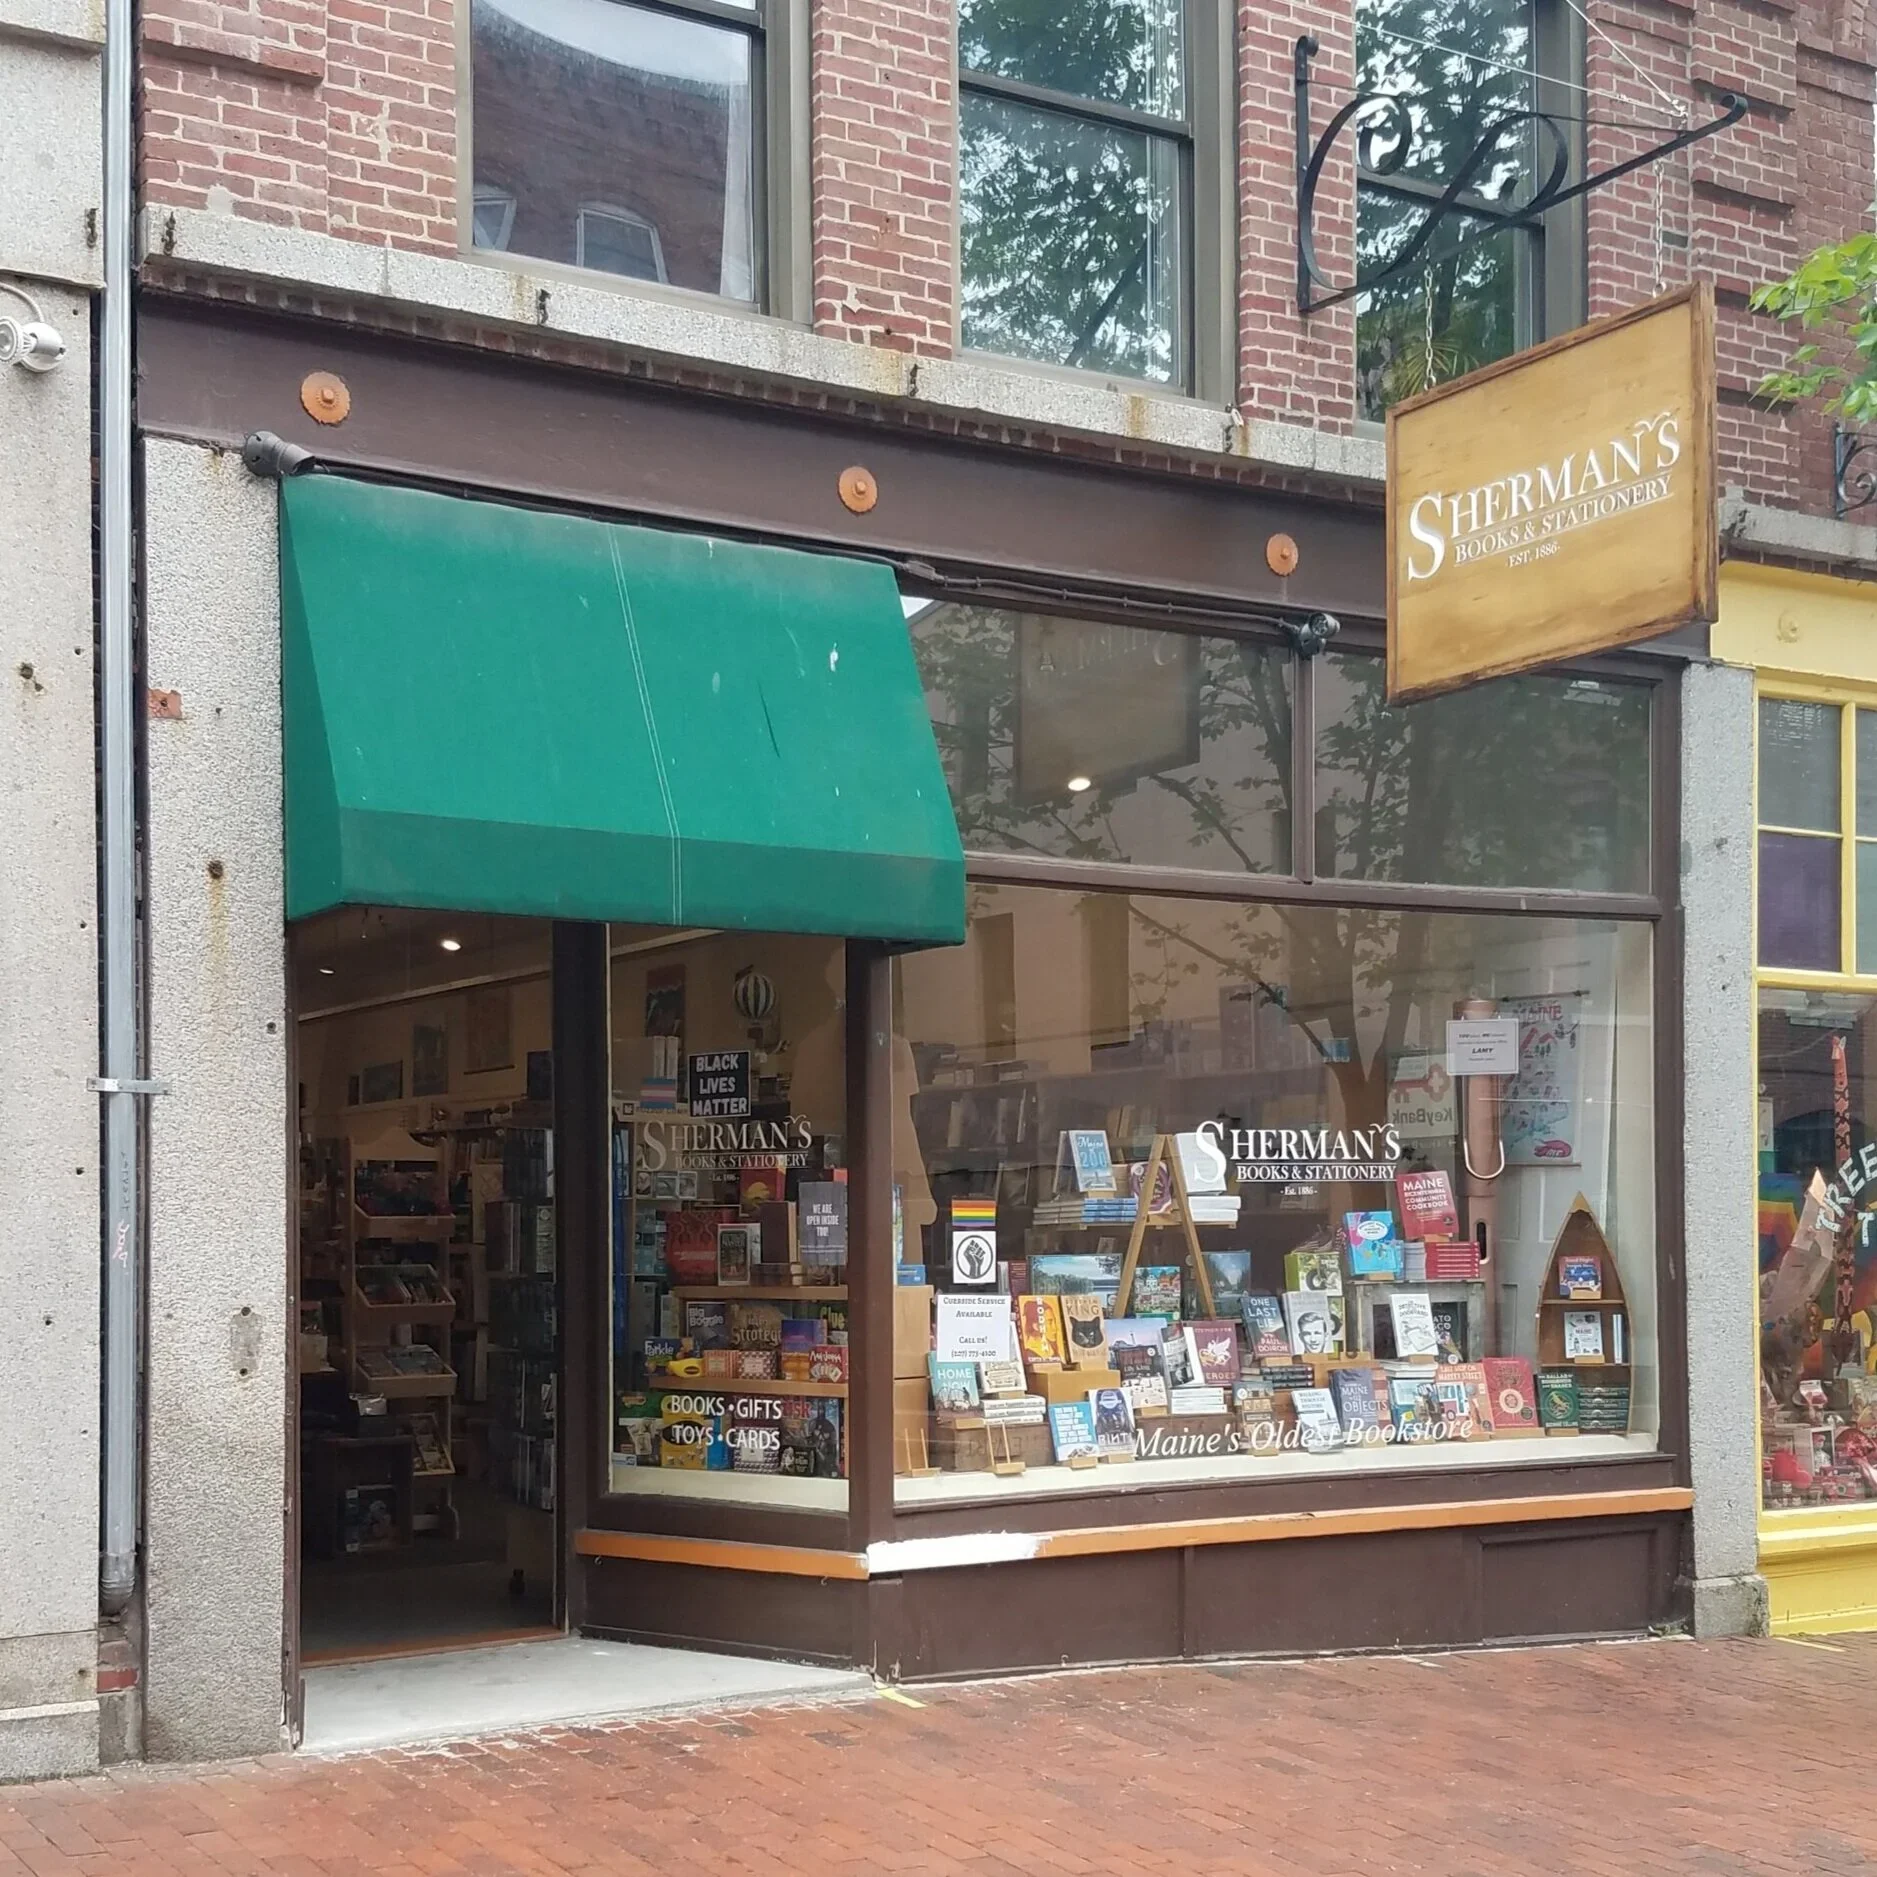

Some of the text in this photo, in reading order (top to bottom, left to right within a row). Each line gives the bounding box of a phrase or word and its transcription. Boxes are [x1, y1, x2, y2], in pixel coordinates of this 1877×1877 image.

[1407, 411, 1681, 581] SHERMAN'S
[1455, 475, 1671, 564] BOOKS & STATIONERY
[696, 1054, 739, 1073] BLACK
[700, 1077, 736, 1095] LIVES
[692, 1097, 747, 1116] MATTER
[643, 1115, 812, 1172] SHERMAN'S
[1077, 1136, 1104, 1149] Maine
[1194, 1120, 1400, 1183] SHERMAN'S
[675, 1153, 808, 1169] BOOKS & STATIONERY
[1081, 1151, 1107, 1169] 200
[1237, 1166, 1397, 1180] BOOKS & STATIONERY
[1403, 1178, 1445, 1192] MAINE
[1405, 1195, 1447, 1204] COMMUNITY
[1406, 1201, 1449, 1211] COOKBOOK
[812, 1204, 833, 1214] WE ARE
[806, 1216, 819, 1226] OPEN
[1250, 1298, 1271, 1306] ONE
[689, 1307, 705, 1319] Big
[1066, 1305, 1100, 1316] KING
[1248, 1308, 1277, 1317] LAST
[1256, 1318, 1275, 1328] LIE
[644, 1340, 675, 1356] Farkle
[937, 1368, 972, 1379] HOME
[1205, 1372, 1236, 1380] EROES
[1341, 1386, 1368, 1395] MAINE
[671, 1395, 724, 1416] BOOKS
[736, 1399, 782, 1420] GIFTS
[1343, 1400, 1388, 1414] OBJECTS
[672, 1424, 714, 1446] TOYS
[725, 1428, 781, 1450] CARDS
[1134, 1416, 1473, 1457] Maine's Oldest Bookstore
